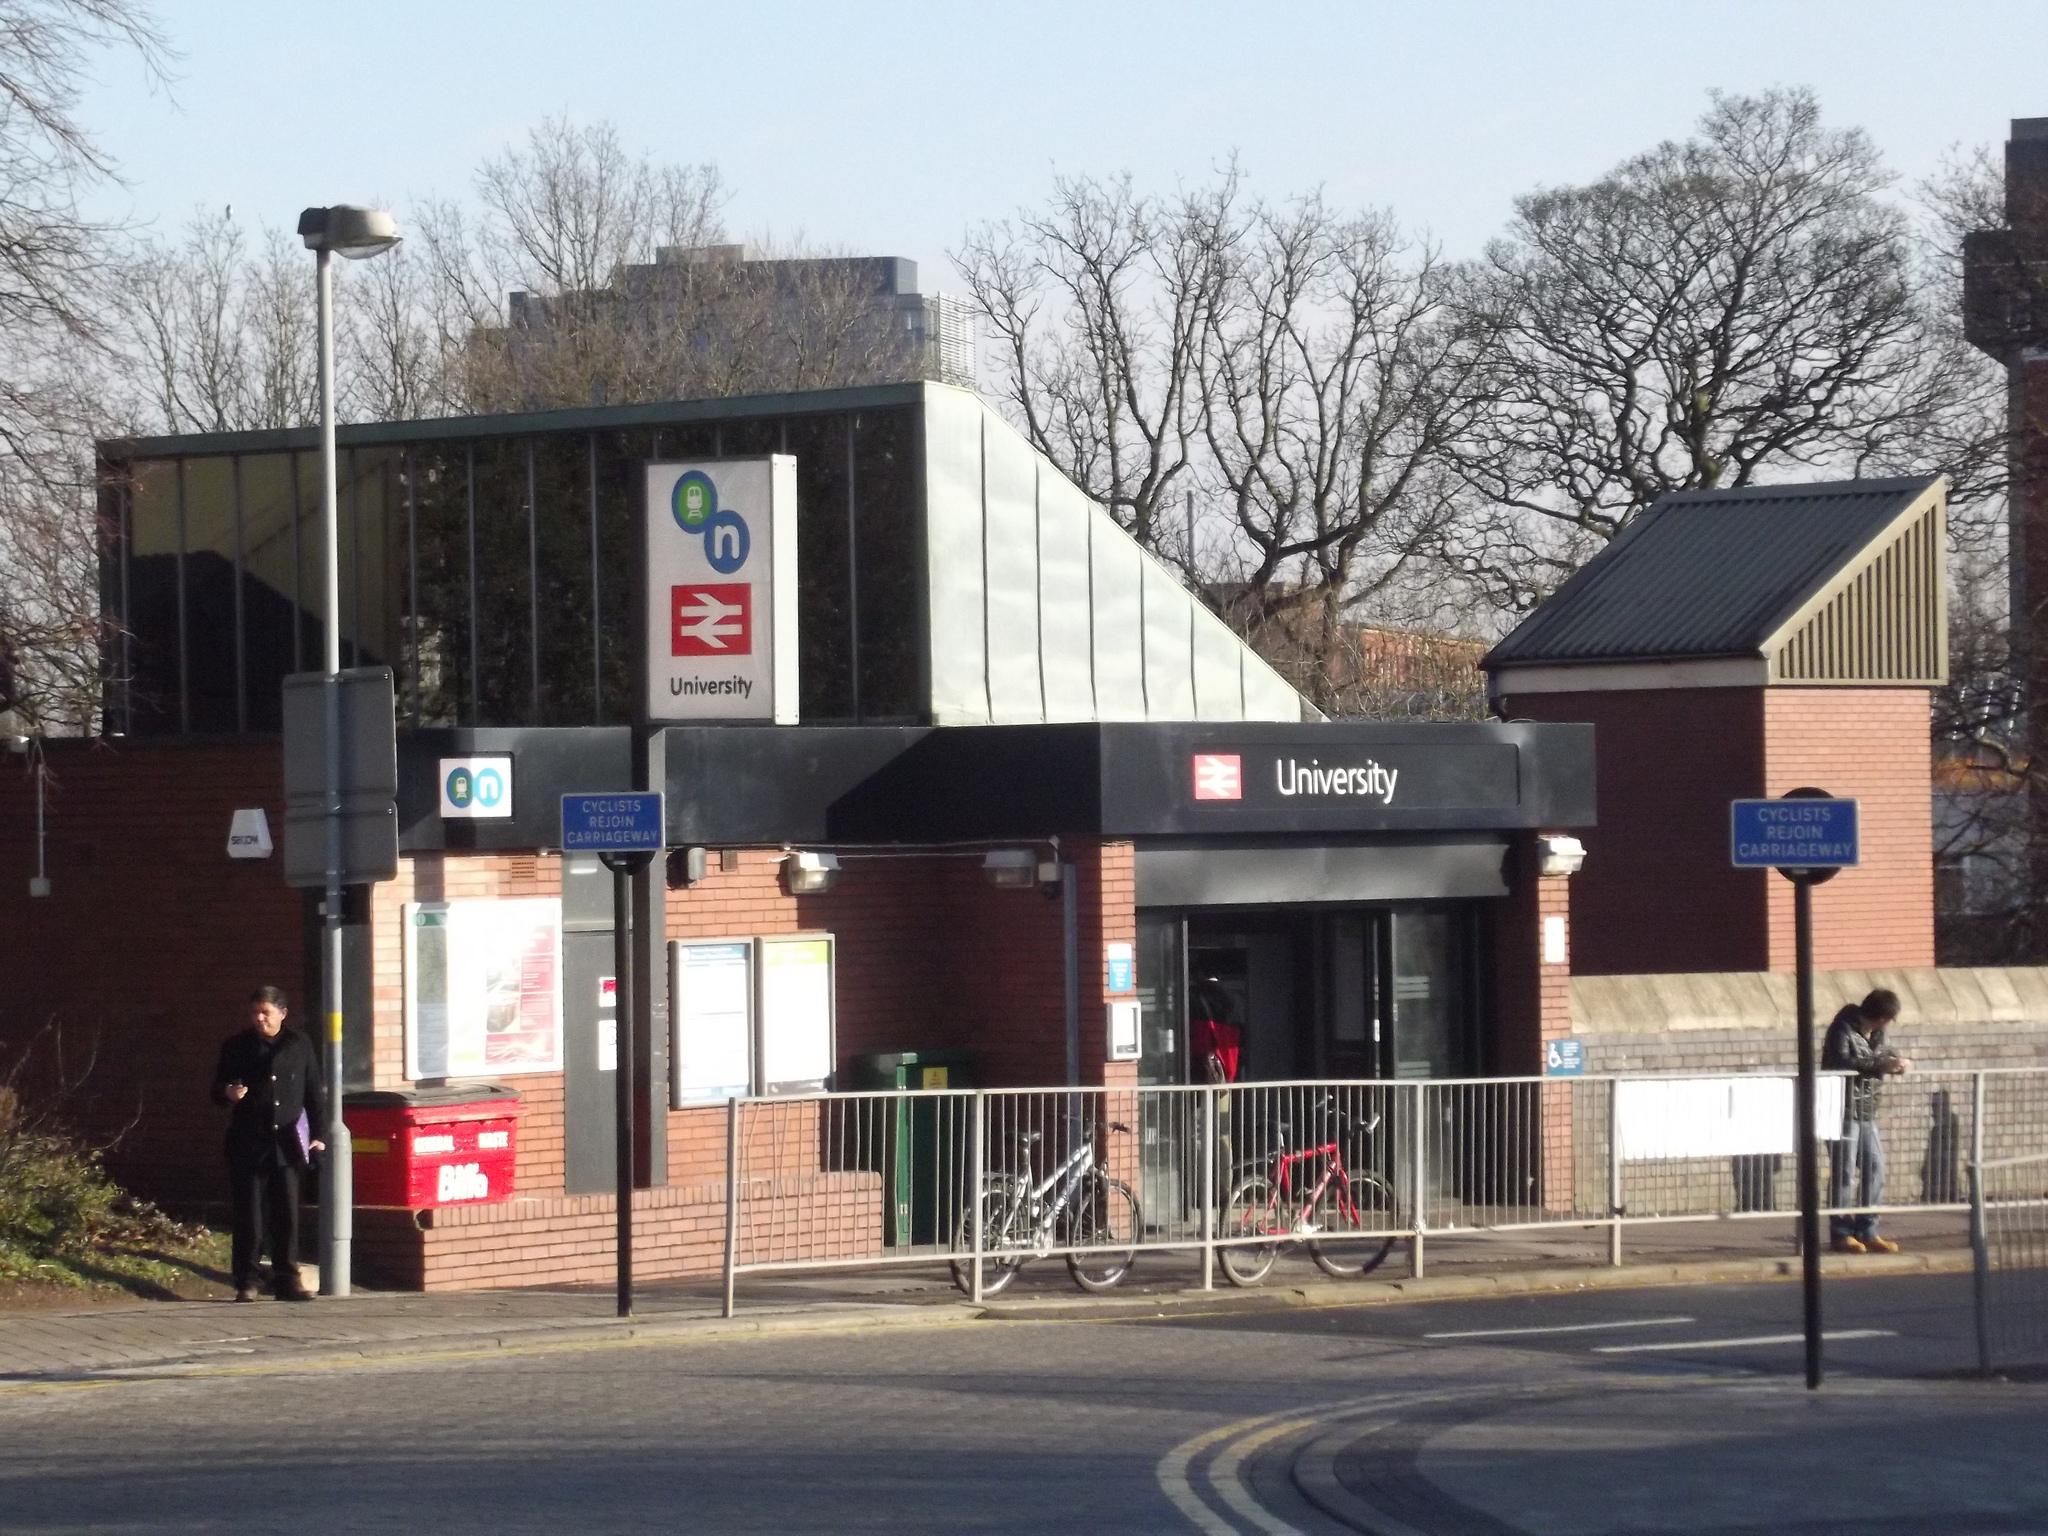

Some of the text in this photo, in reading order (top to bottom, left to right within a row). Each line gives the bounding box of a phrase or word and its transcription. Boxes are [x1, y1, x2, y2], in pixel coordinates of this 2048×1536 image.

[669, 674, 753, 700] University
[1276, 758, 1399, 805] University
[582, 799, 641, 813] CYCLISTS
[589, 815, 635, 828] REJOIN
[1758, 807, 1832, 822] CYCLISTS
[566, 830, 658, 844] CARRIAGEWAY
[1766, 825, 1824, 839] REJOIN
[1739, 842, 1853, 858] CARRIAGEWAY
[414, 1130, 509, 1154] GENERAL WASTE
[437, 1162, 489, 1203] Biffa
